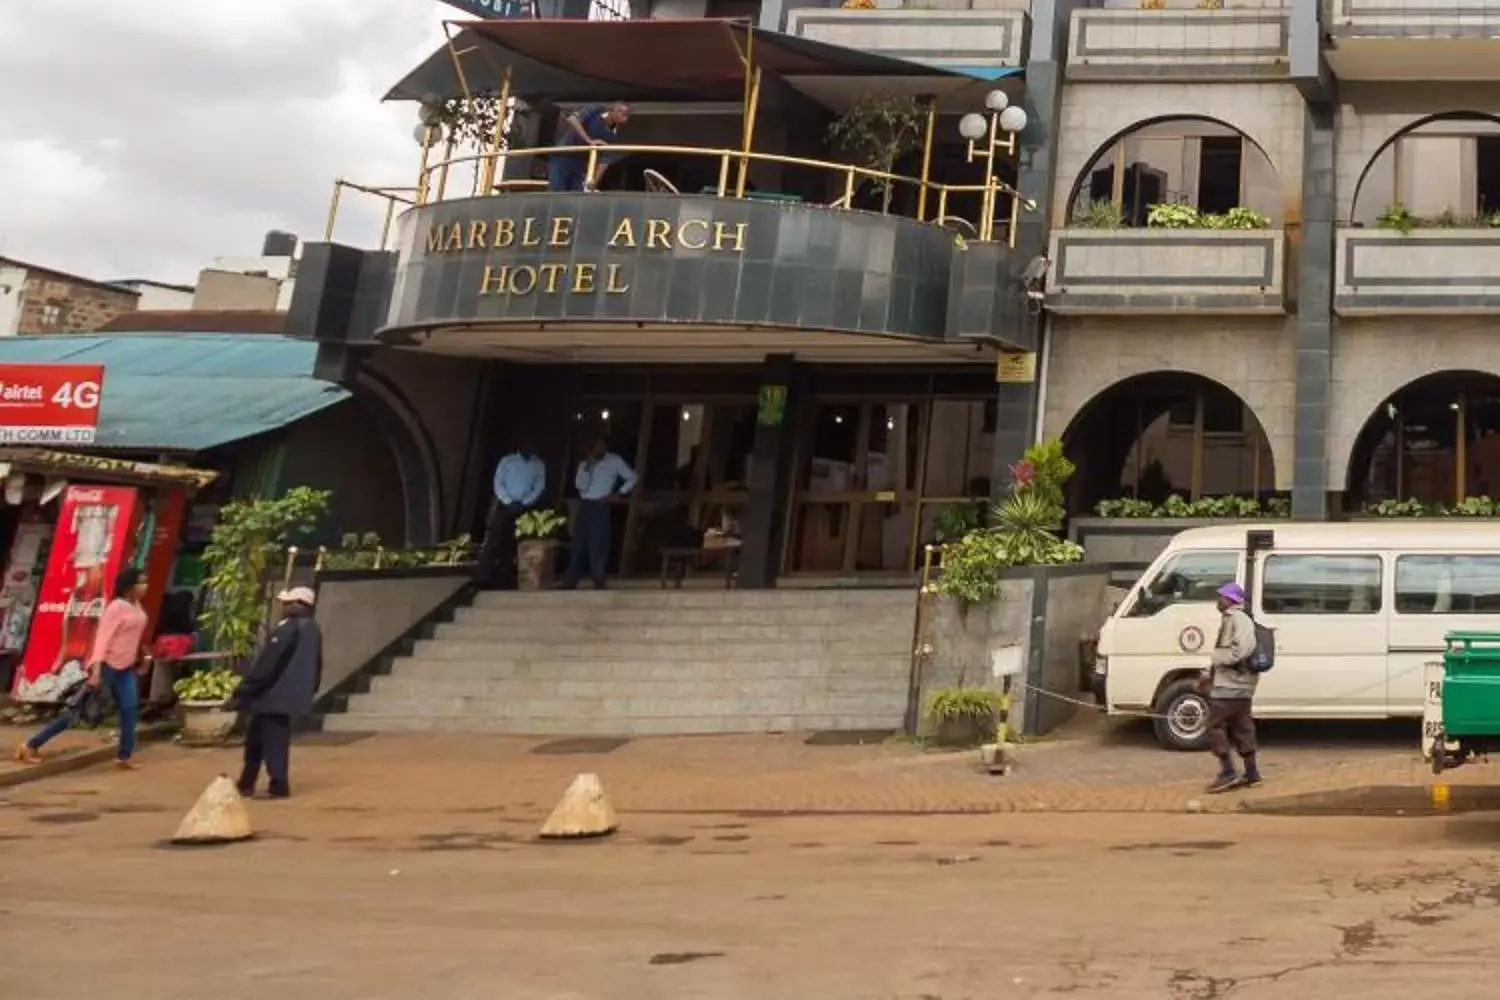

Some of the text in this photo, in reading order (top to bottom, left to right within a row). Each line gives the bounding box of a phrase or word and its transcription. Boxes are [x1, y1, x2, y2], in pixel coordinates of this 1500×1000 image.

[424, 216, 749, 254] MARBLE ARCH
[478, 262, 633, 297] HOTEL
[3, 380, 100, 410] airtel 4G
[65, 429, 92, 441] LTD
